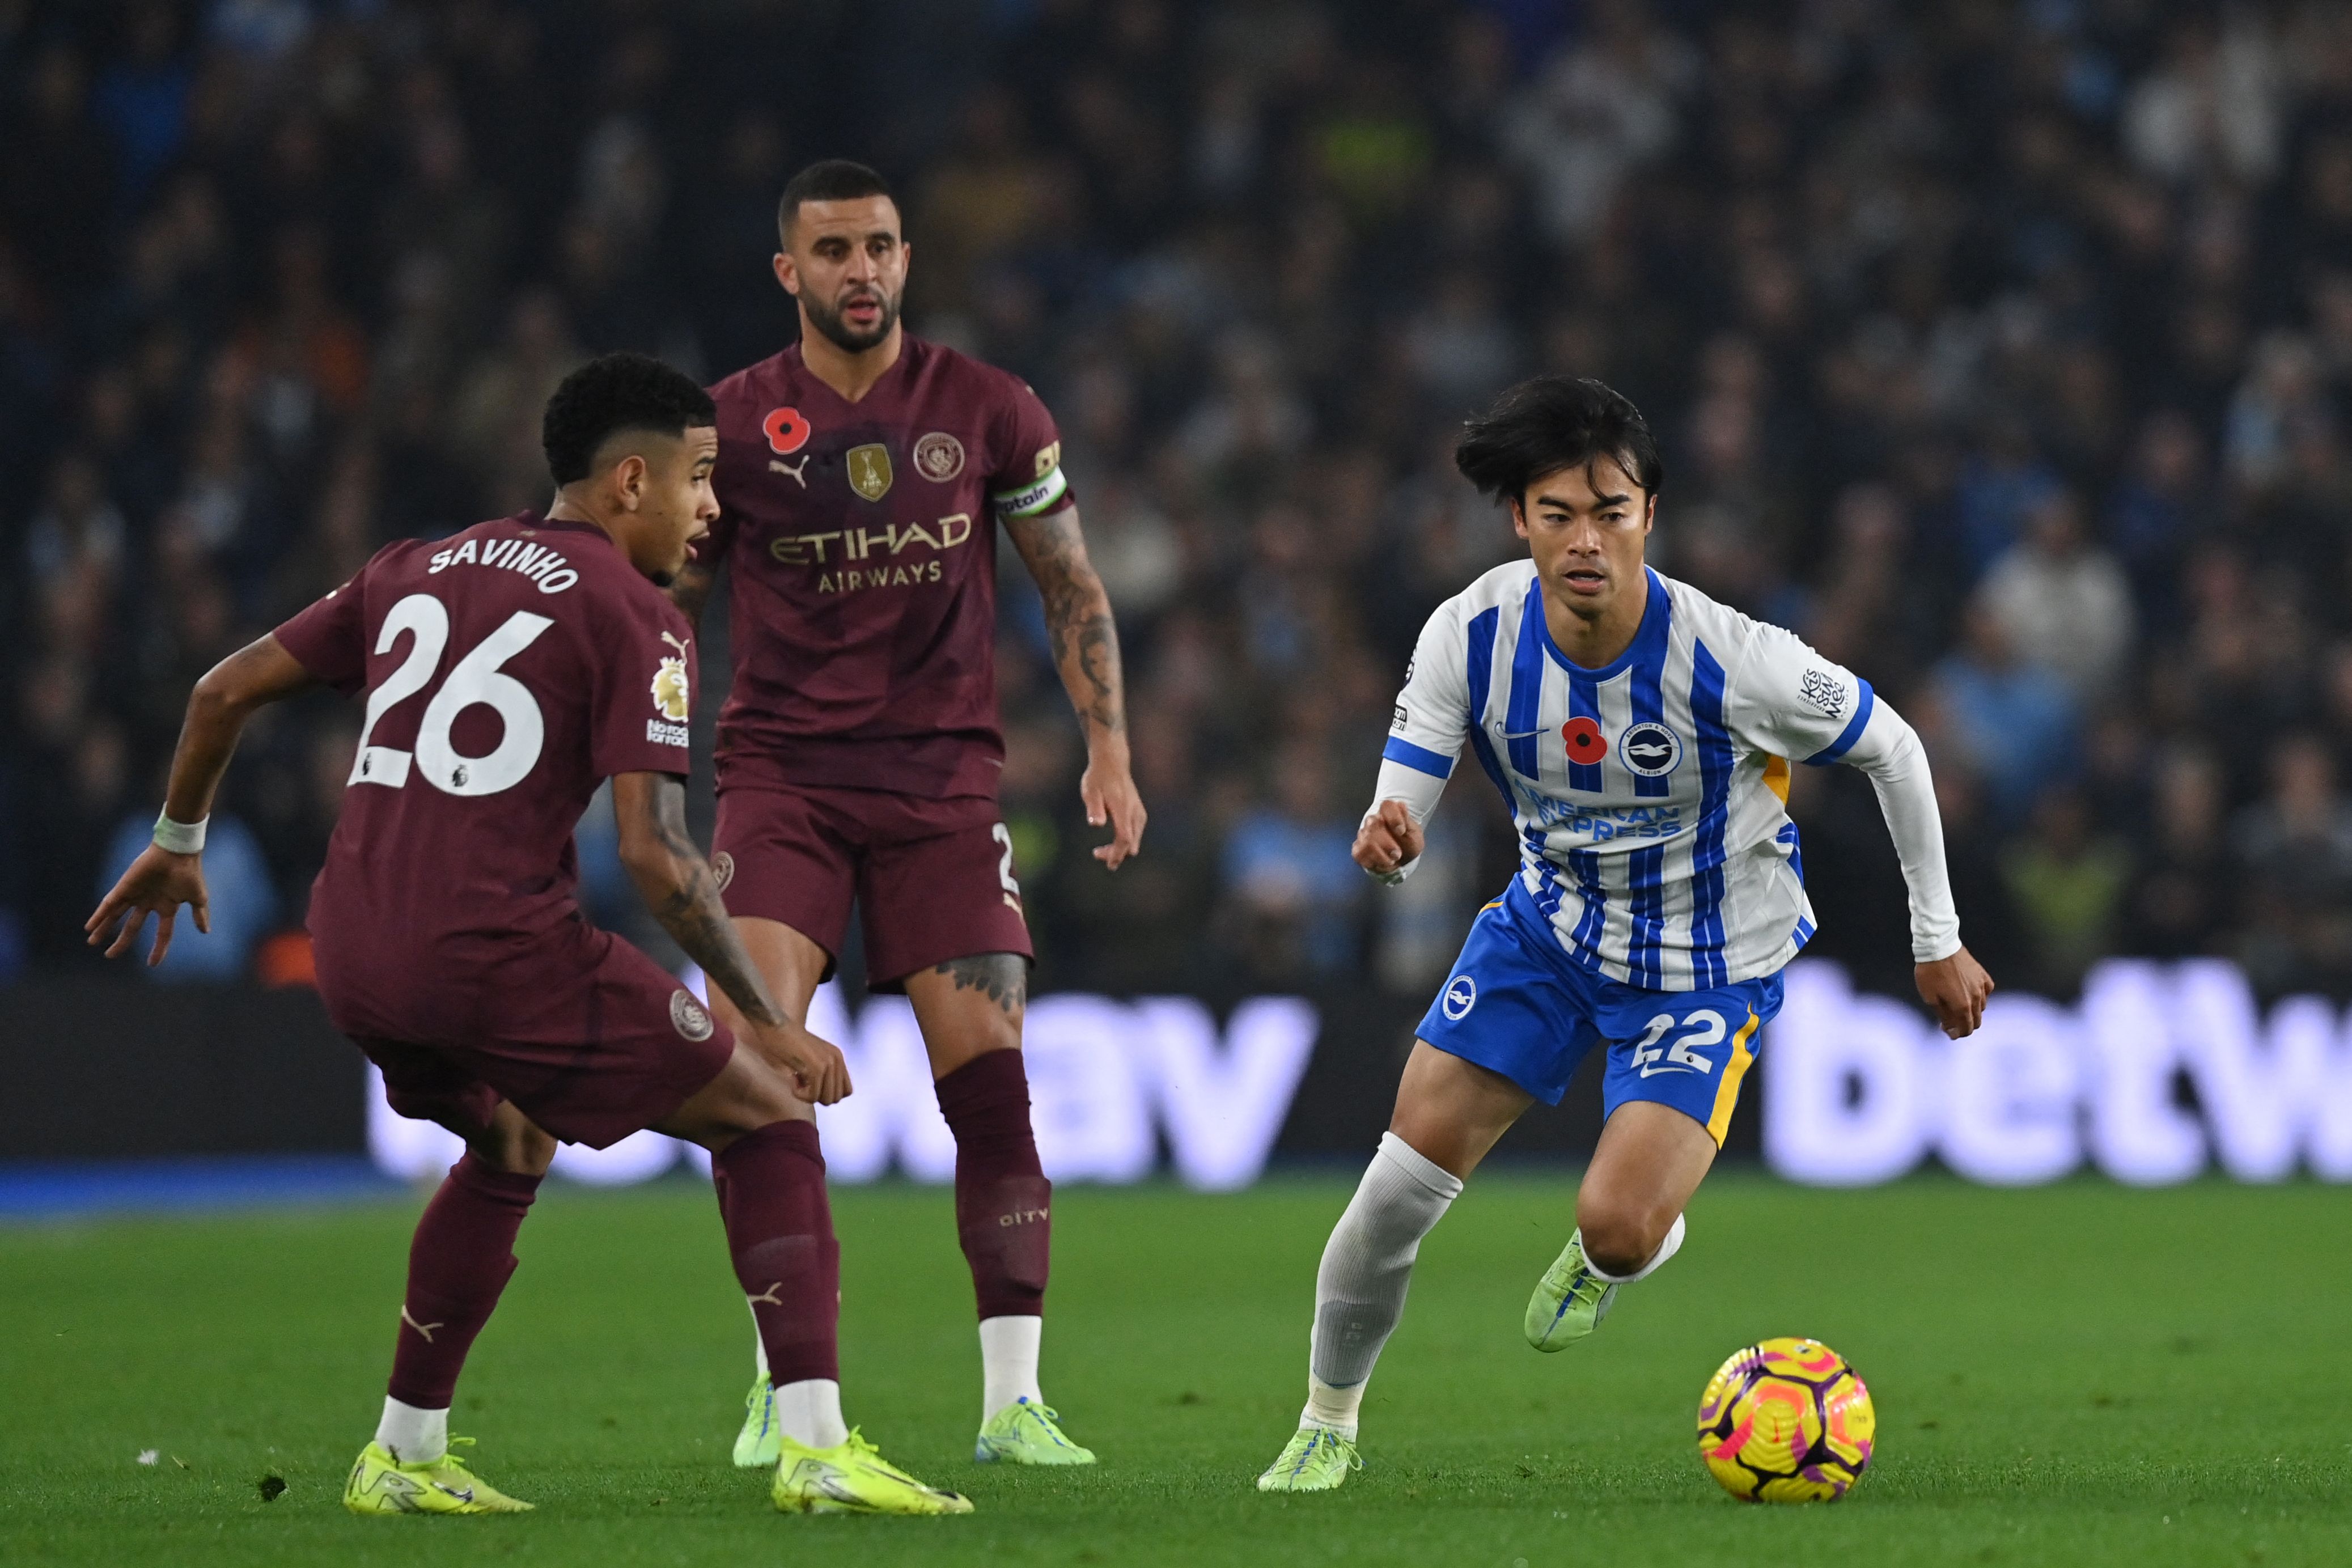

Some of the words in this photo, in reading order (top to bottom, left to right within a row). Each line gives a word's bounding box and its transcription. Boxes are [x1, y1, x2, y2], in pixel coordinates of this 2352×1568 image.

[428, 539, 579, 594] SAVINHO
[770, 513, 972, 565] ETIHAD
[819, 561, 942, 594] AIRWAYS
[346, 594, 556, 796] 26
[1626, 724, 1652, 738] BRIGHTON
[1660, 728, 1674, 740] HOVE
[992, 822, 1020, 896] 2
[1630, 1009, 1726, 1074] 22
